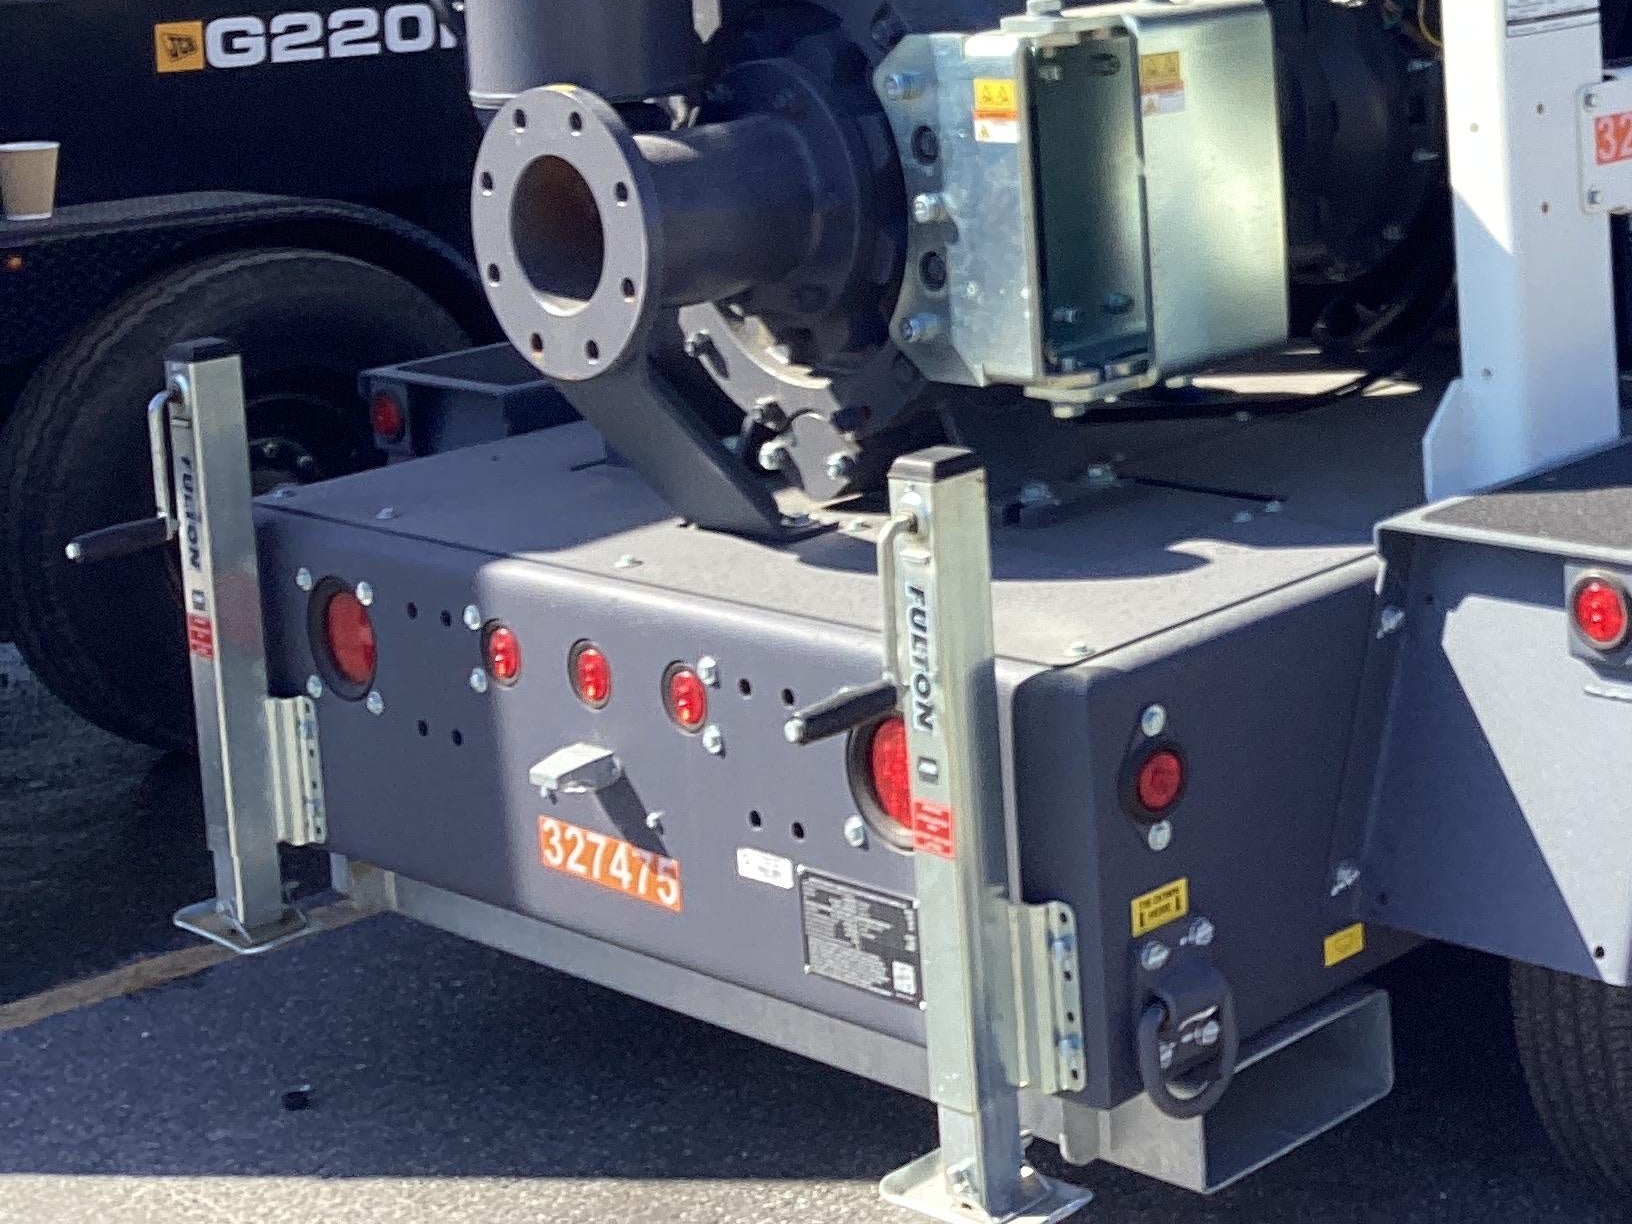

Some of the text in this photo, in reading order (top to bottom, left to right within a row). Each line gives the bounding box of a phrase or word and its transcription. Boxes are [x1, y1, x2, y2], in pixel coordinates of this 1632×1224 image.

[181, 456, 203, 570] FULTON
[908, 585, 934, 732] FULTON
[542, 818, 680, 907] 327475
